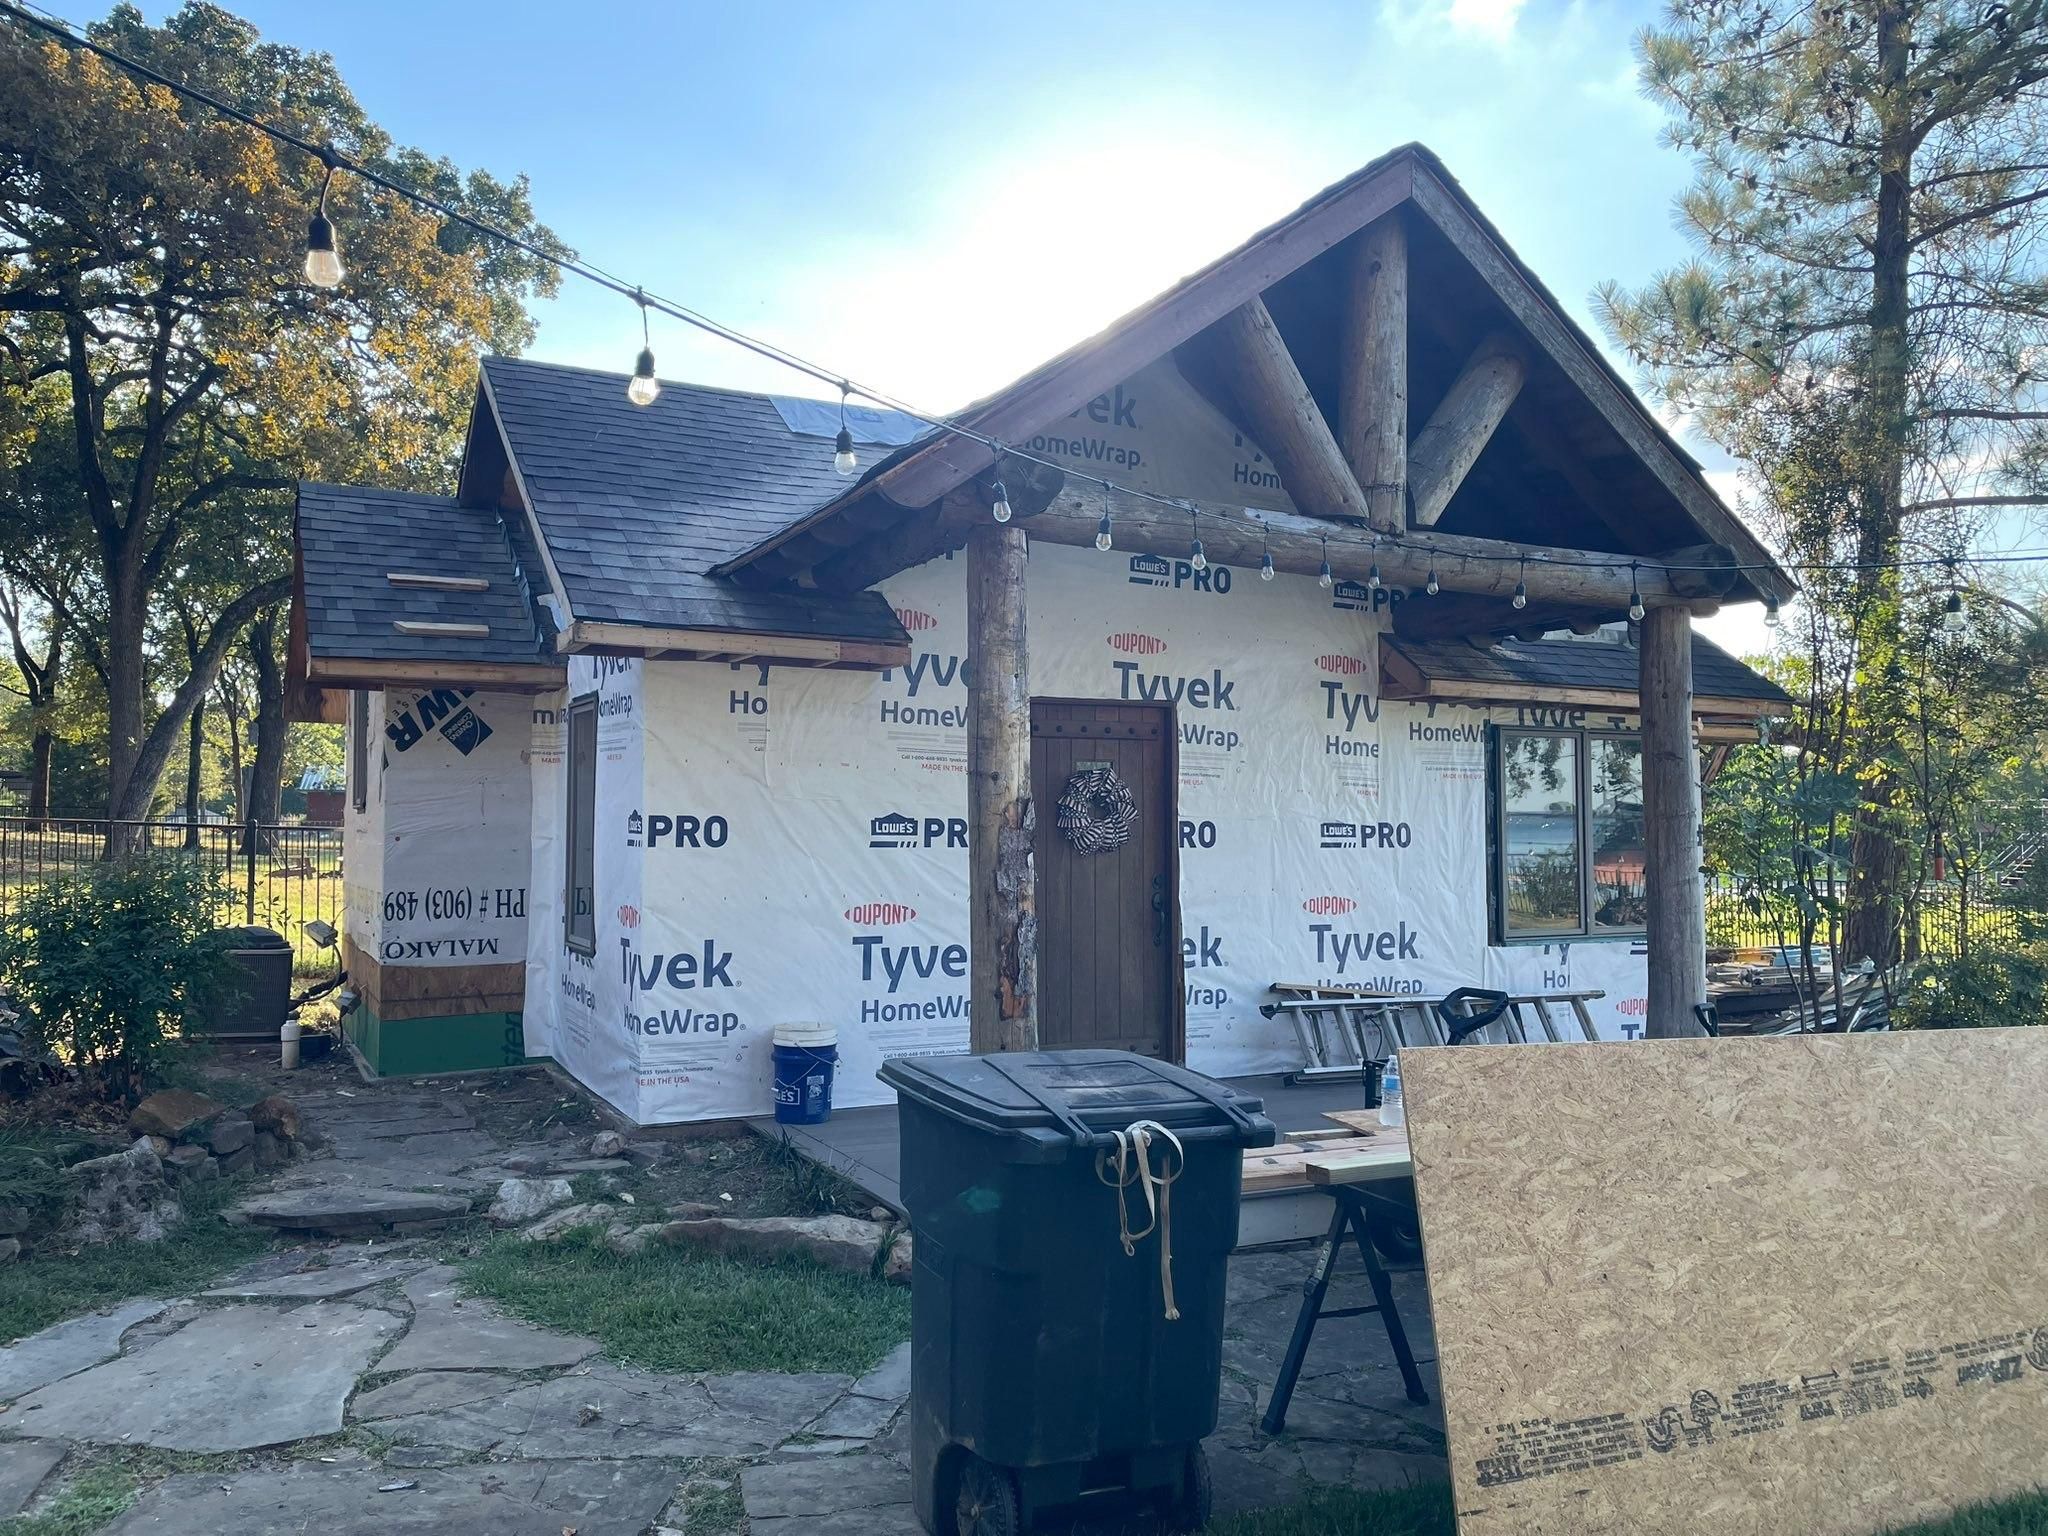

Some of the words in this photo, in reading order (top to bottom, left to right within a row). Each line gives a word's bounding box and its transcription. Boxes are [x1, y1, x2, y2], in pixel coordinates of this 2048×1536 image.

[1068, 384, 1136, 429] ek
[1025, 435, 1140, 470] omeWrap
[1234, 462, 1280, 489] Hom
[1135, 559, 1166, 573] LOWE'S
[1175, 561, 1231, 594] PRO
[1114, 633, 1161, 654] DUPONT
[1320, 655, 1362, 674] DUPONT
[730, 690, 767, 714] Ho
[1320, 680, 1379, 732] Tyv
[1326, 735, 1379, 758] Home
[648, 815, 728, 848] PRO
[876, 822, 913, 834] LOWE'S
[1179, 821, 1216, 848] RO
[1324, 825, 1353, 837] LOWE'S
[1361, 822, 1412, 848] PRO
[384, 889, 419, 921] 489
[425, 886, 472, 919] (903)
[496, 889, 526, 917] PH
[853, 903, 910, 926] DUPONT
[1309, 896, 1352, 915] DUPONT
[383, 937, 499, 960] MALAKO
[1309, 921, 1418, 973] Tyvek
[620, 937, 733, 1001] Tyvek
[852, 935, 967, 993] Tyve
[674, 1076, 690, 1084] USA
